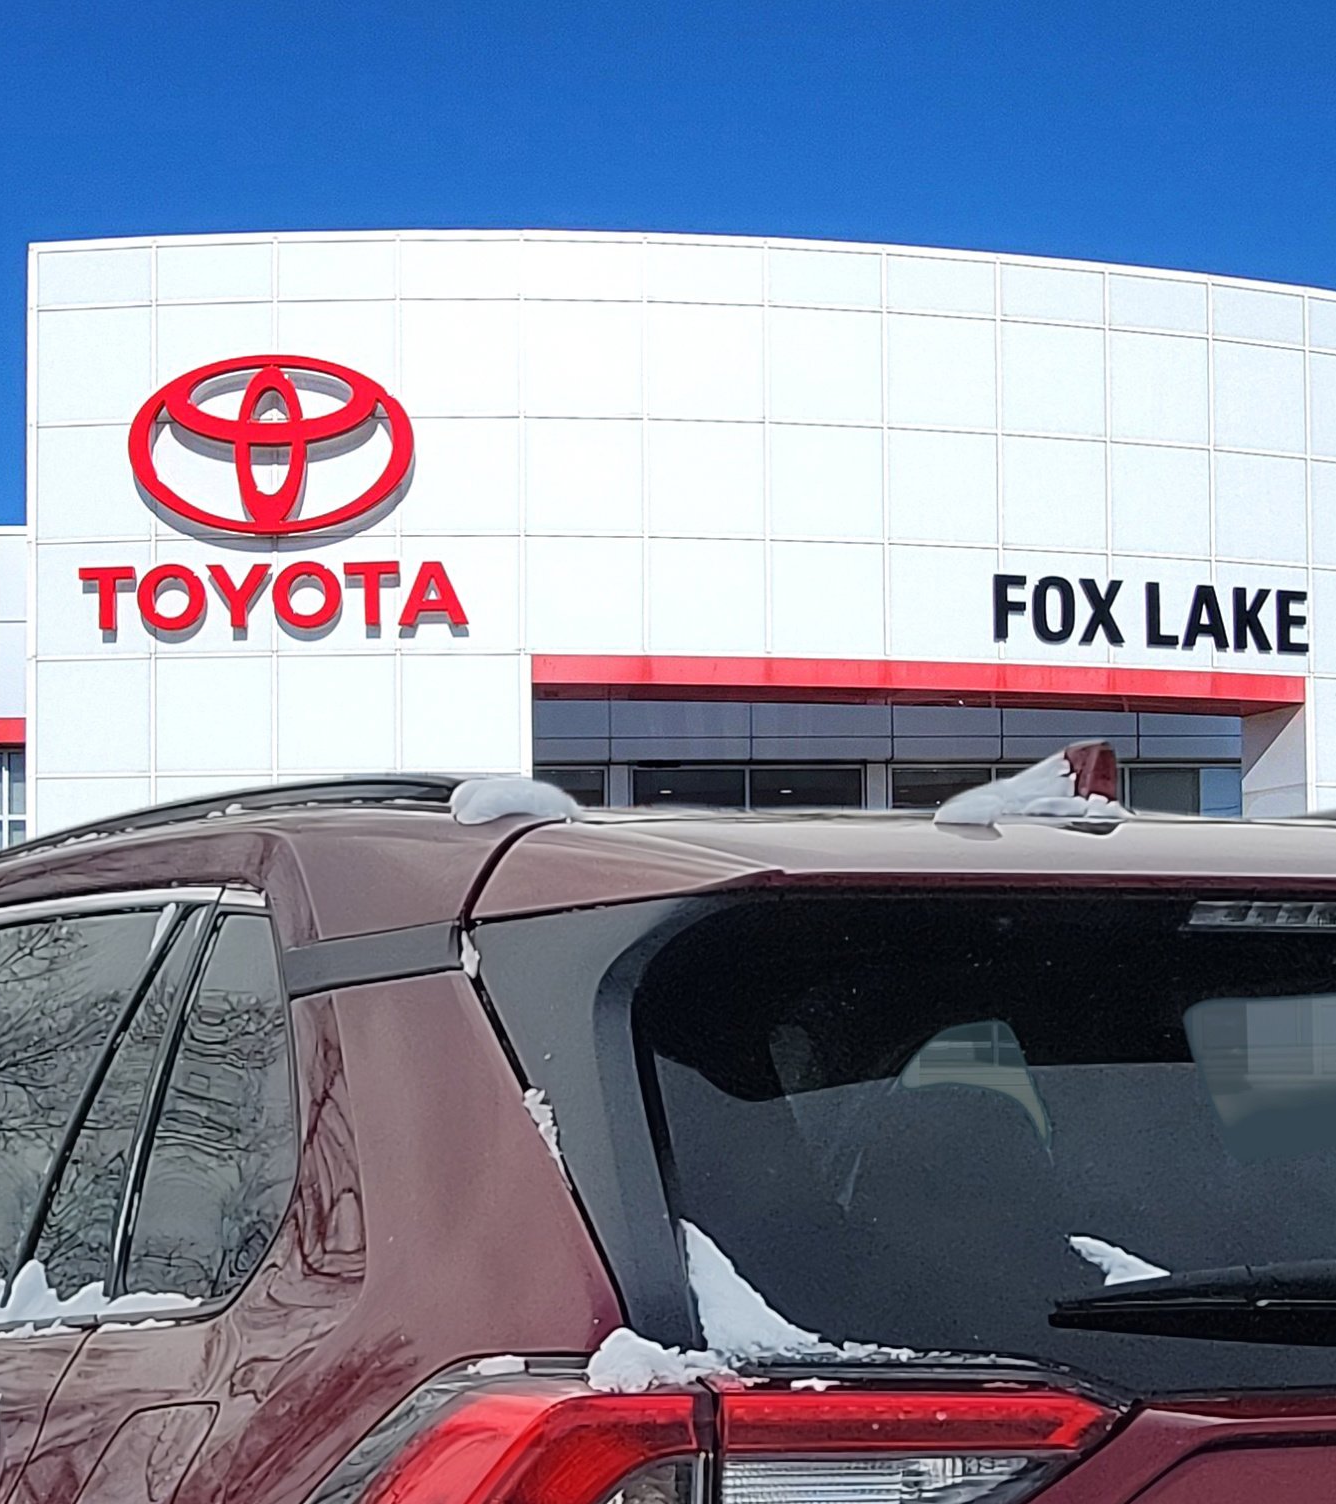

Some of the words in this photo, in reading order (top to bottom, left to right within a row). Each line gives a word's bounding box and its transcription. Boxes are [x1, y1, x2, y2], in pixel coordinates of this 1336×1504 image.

[79, 561, 469, 632] TOYOTA
[993, 573, 1125, 645] FOX
[1145, 581, 1309, 653] LAKE
